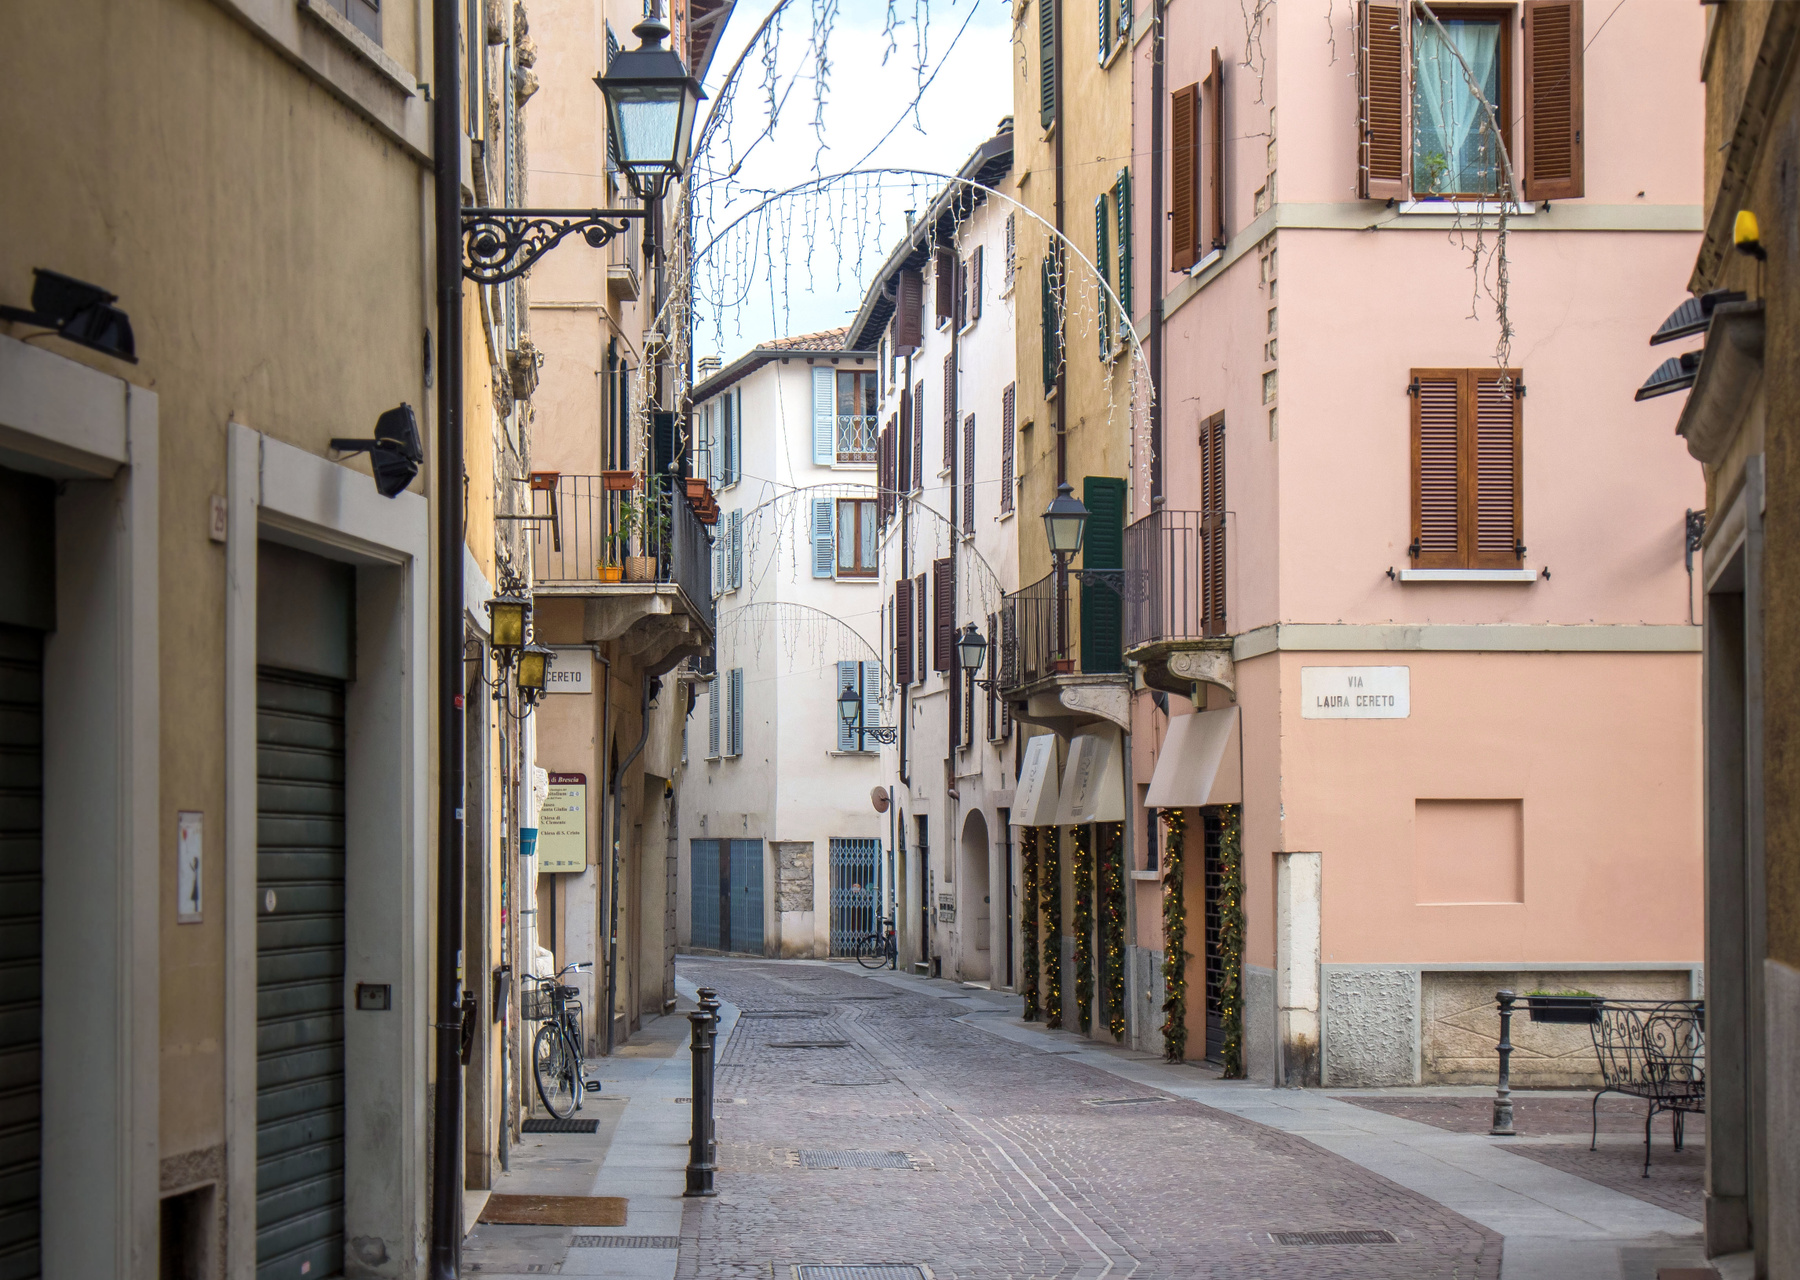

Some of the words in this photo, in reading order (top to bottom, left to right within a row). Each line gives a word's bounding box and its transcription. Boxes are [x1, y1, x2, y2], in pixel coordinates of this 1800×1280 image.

[547, 671, 582, 682] CERETO
[1347, 676, 1364, 688] VIA
[1317, 695, 1350, 708] LAURA
[1356, 695, 1395, 707] CERETO
